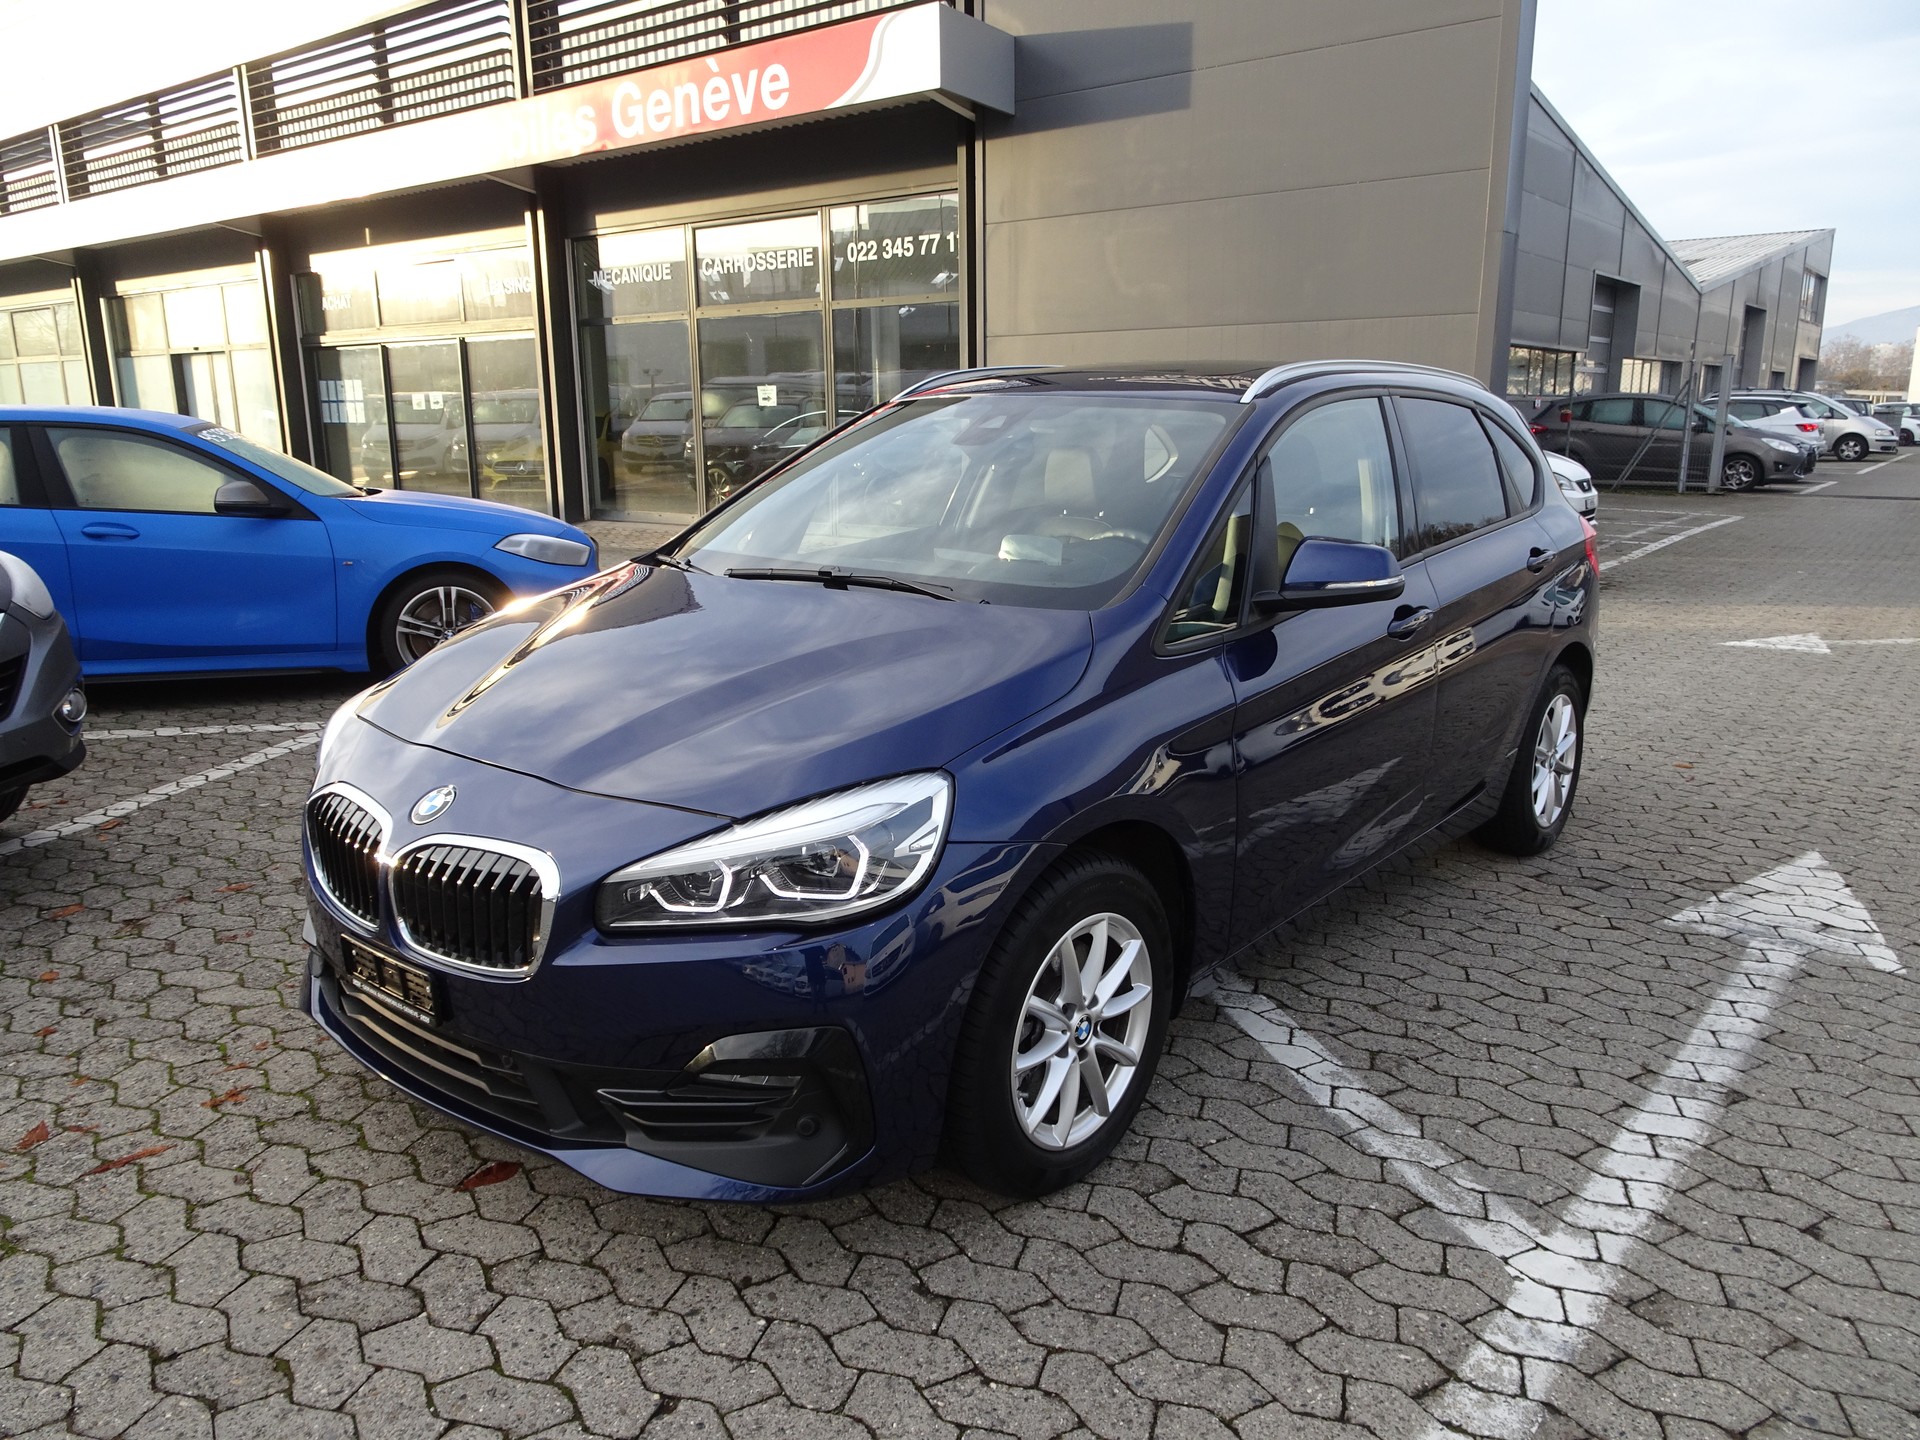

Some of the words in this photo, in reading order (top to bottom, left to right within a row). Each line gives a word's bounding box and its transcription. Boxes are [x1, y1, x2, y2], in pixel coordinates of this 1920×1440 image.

[611, 58, 790, 139] Genève
[701, 247, 814, 276] CARROSSERIE
[846, 240, 878, 263] 022
[882, 236, 914, 260] 345
[918, 233, 941, 256] 77
[322, 296, 352, 311] ACHAT
